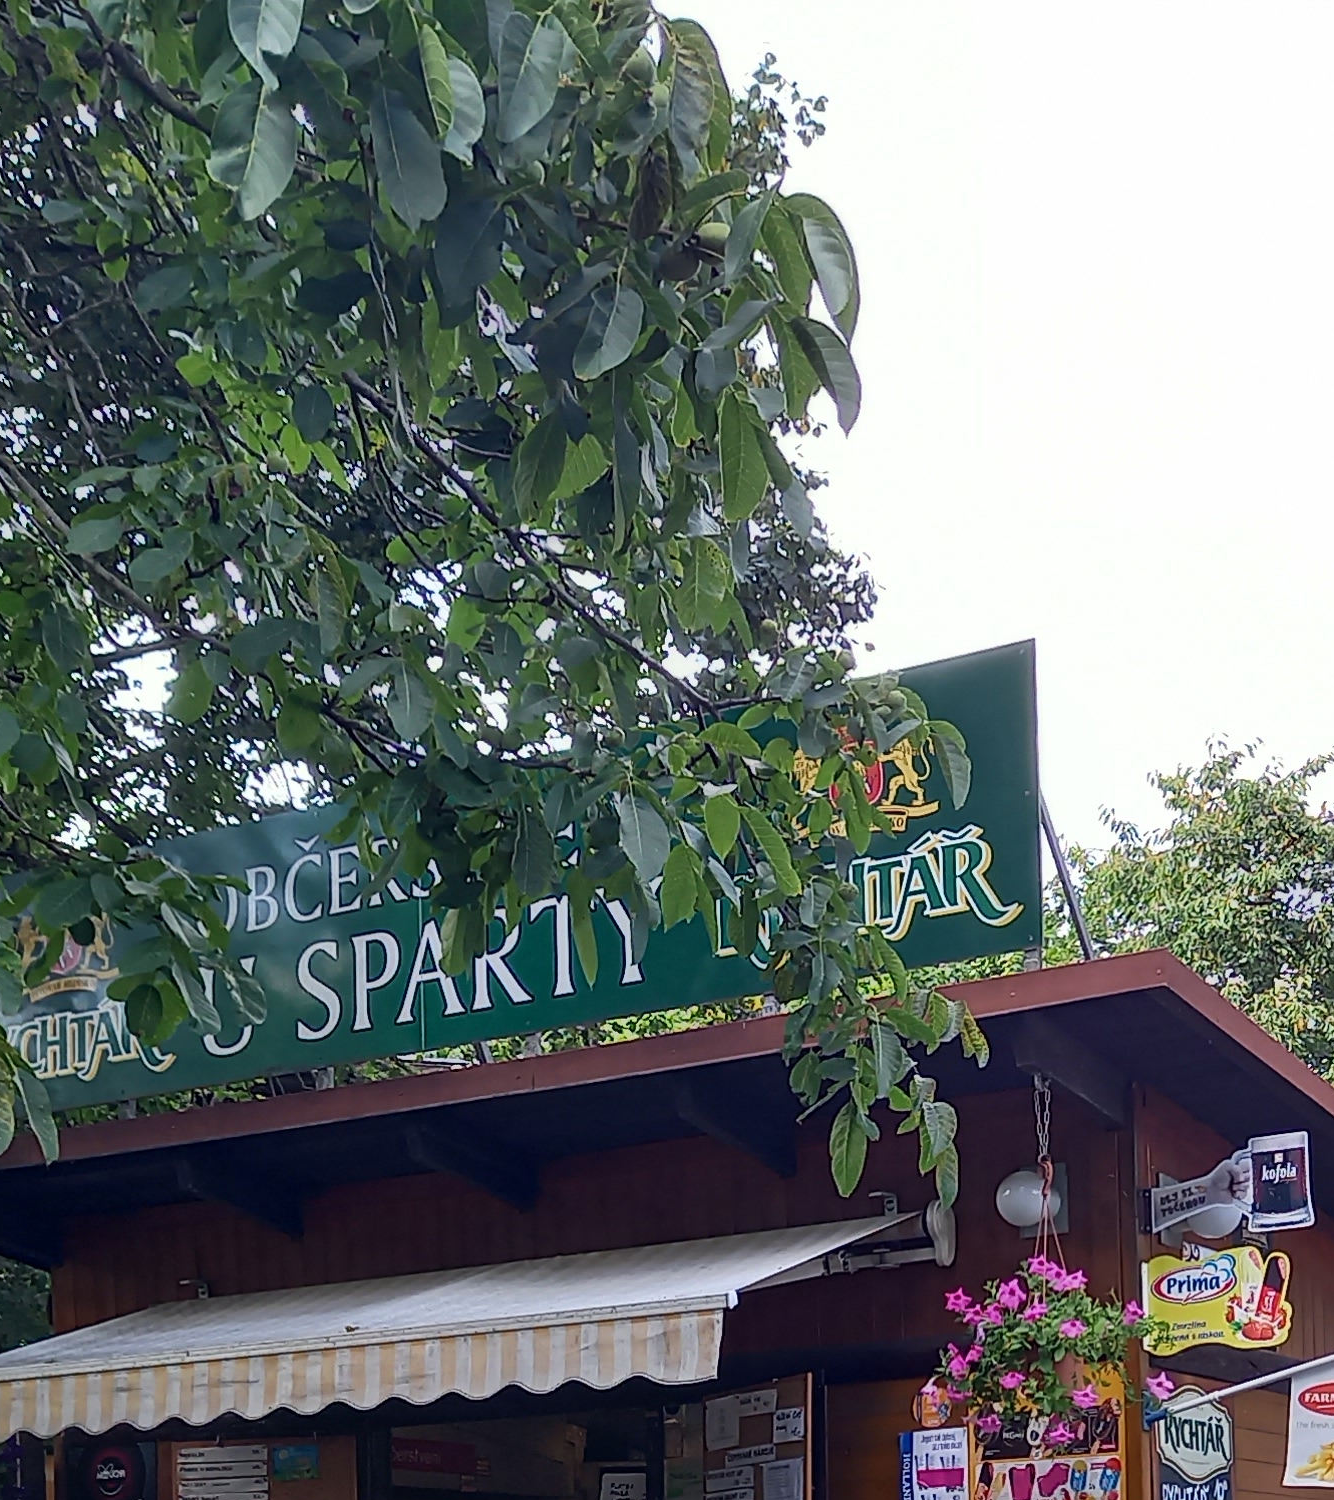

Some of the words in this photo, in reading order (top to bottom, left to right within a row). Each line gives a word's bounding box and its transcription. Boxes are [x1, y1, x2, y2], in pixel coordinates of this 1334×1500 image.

[295, 878, 666, 1042] SPARTY
[1261, 1163, 1297, 1184] kofola
[1167, 1275, 1221, 1295] Prima
[1296, 1421, 1308, 1429] the
[1310, 1421, 1330, 1430] fresh
[1163, 1413, 1230, 1461] RYCHTÁŘ
